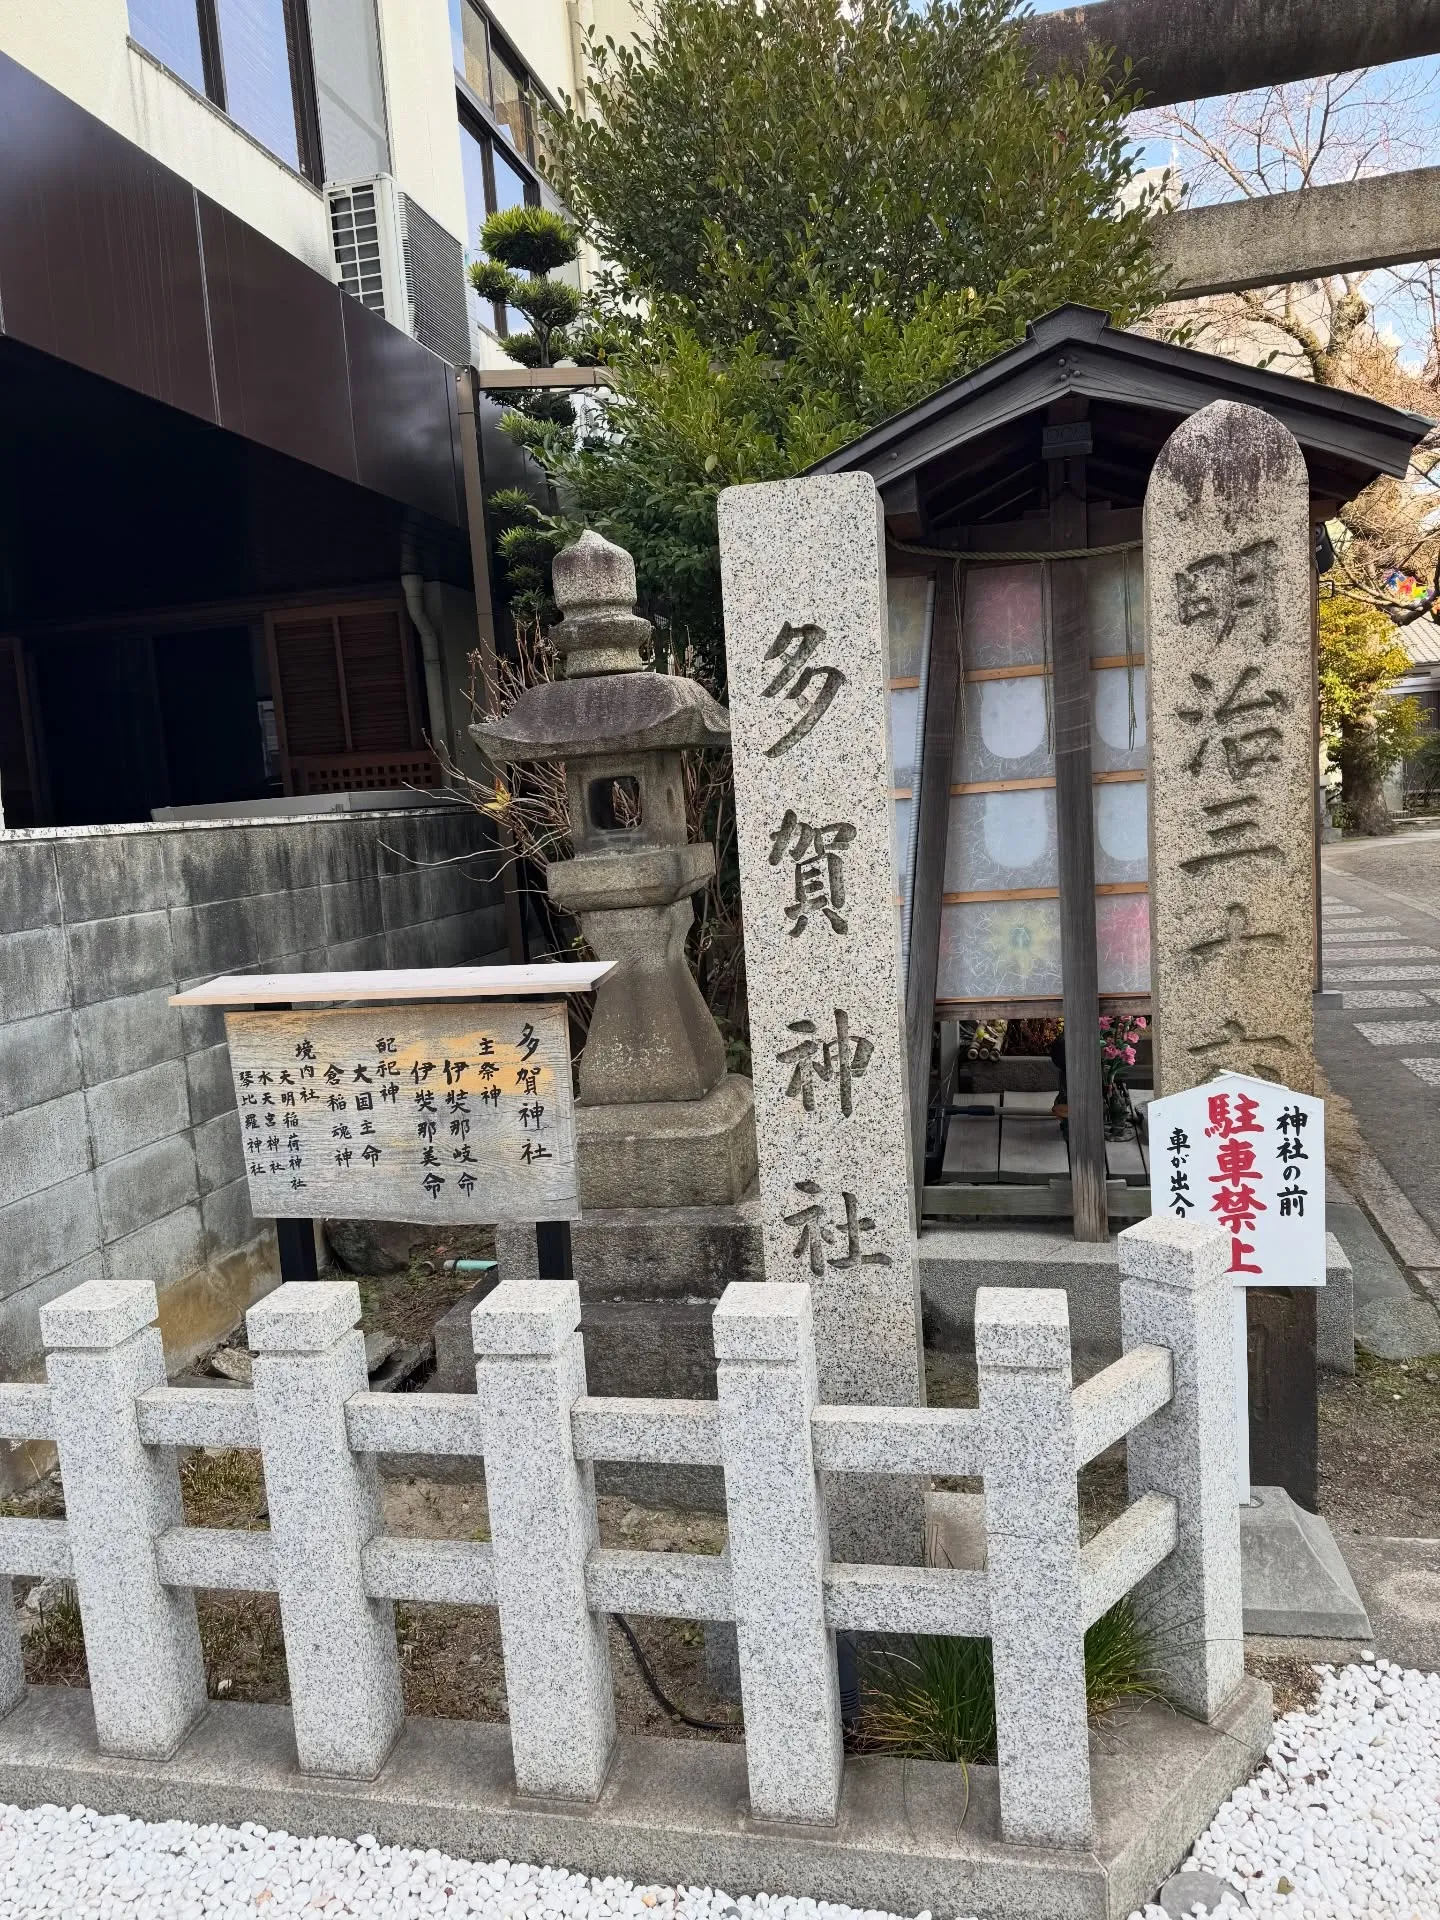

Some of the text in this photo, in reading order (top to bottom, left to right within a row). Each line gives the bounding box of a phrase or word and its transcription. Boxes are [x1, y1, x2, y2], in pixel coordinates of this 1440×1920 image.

[761, 620, 891, 1279] 多賀神社
[257, 1070, 286, 1174] 水天宮神社
[295, 1039, 320, 1104] 境内社
[323, 1063, 352, 1168] 倉稲魂神
[352, 1063, 382, 1168] 大国主命
[375, 1037, 400, 1104] 配祀神
[478, 1038, 501, 1108] 主祭神
[515, 1022, 553, 1165] 多賀神社
[279, 1069, 307, 1191] 天明稲荷神社
[1276, 1105, 1309, 1217] 神社の前
